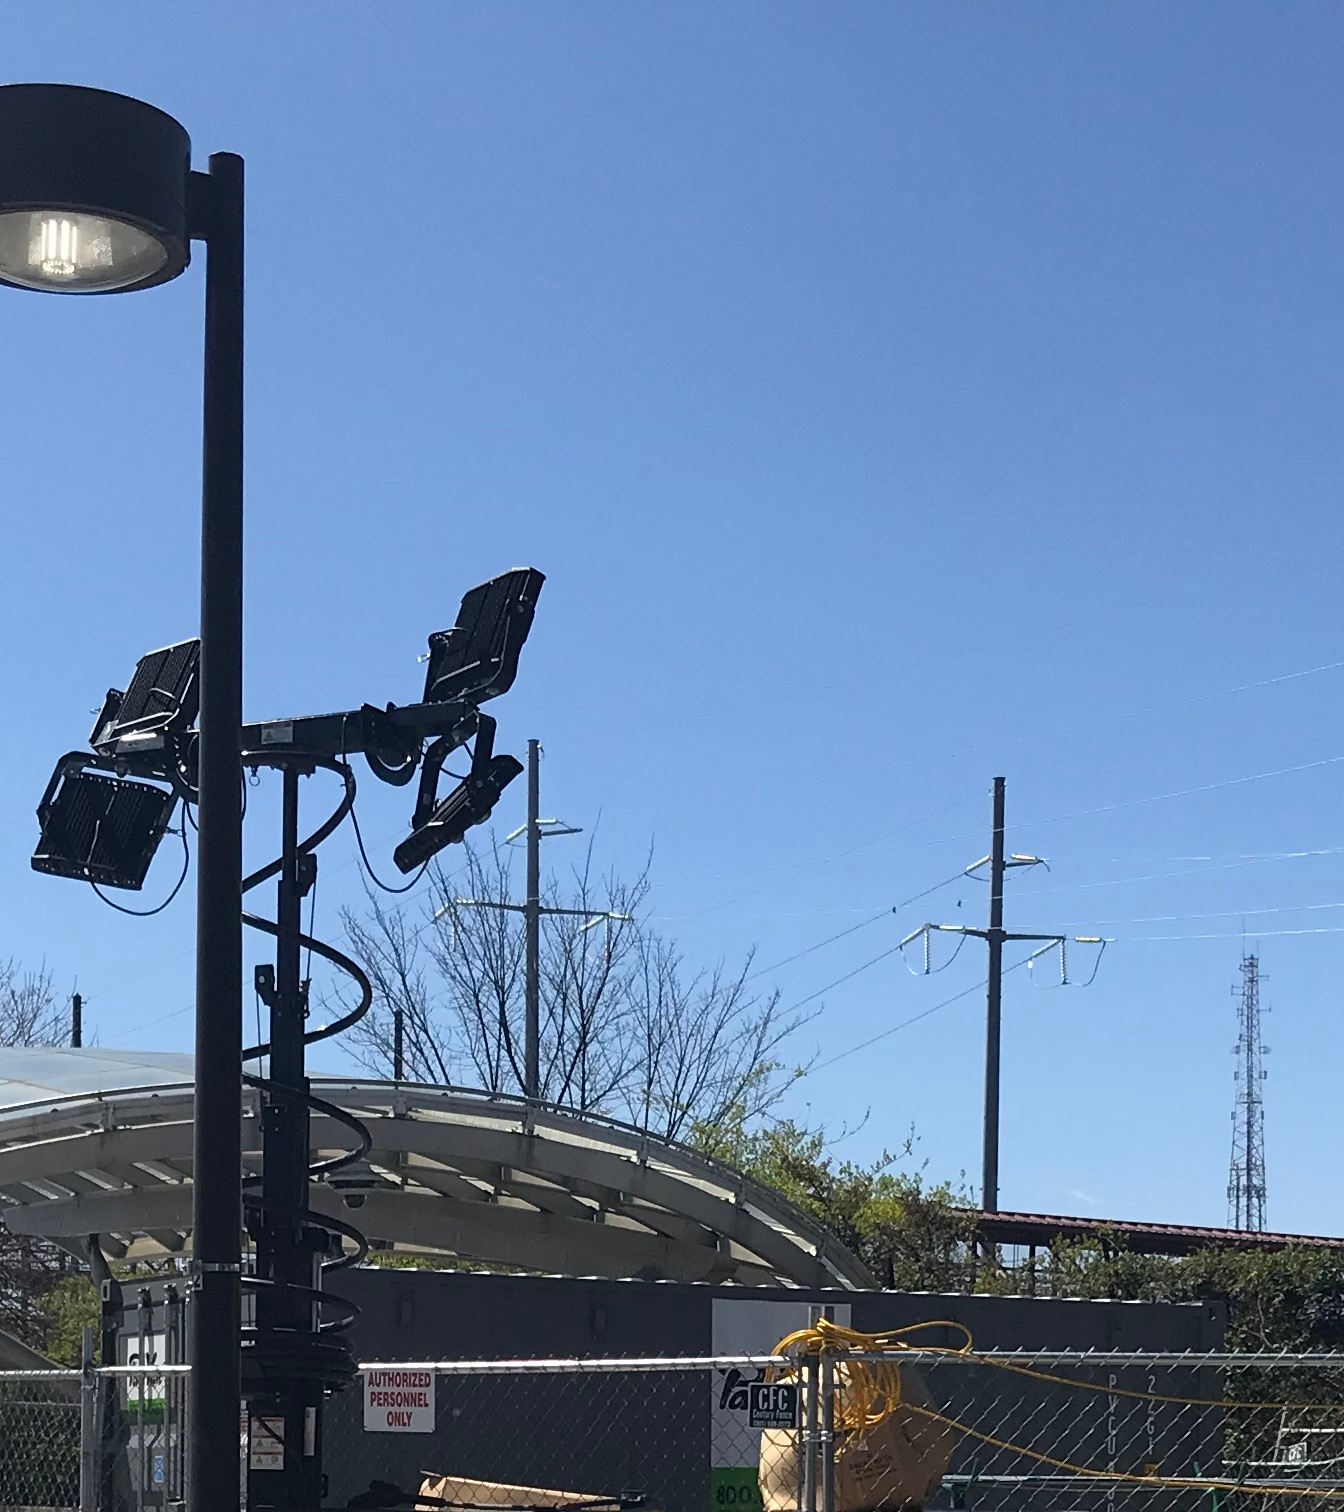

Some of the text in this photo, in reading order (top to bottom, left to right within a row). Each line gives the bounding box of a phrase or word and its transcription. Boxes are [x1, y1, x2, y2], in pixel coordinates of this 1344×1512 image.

[368, 1371, 432, 1388] AUTHORIZED
[370, 1391, 429, 1408] PERSONNEL
[758, 1386, 788, 1411] CFC
[386, 1411, 413, 1427] ONLY
